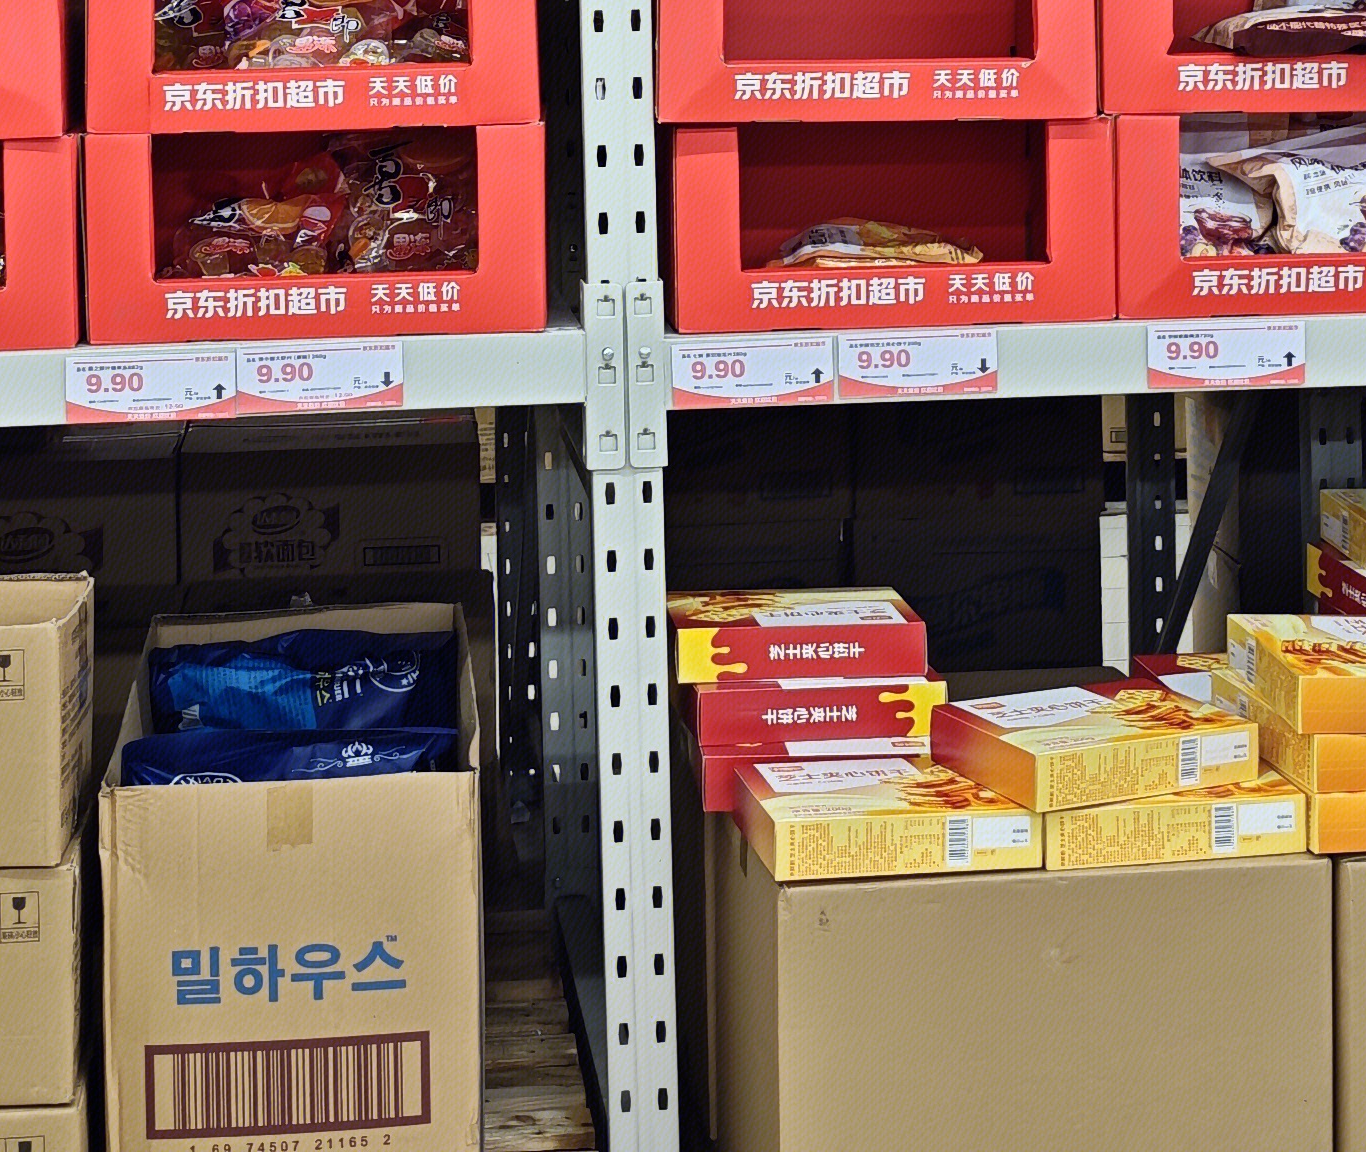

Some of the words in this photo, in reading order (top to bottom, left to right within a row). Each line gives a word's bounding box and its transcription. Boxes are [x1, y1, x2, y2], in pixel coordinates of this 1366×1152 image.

[369, 75, 457, 96] 天天低价
[735, 71, 910, 100] 京东折扣超市
[933, 68, 1019, 87] 天天低价
[1177, 61, 1348, 91] 京东折扣超市
[163, 79, 345, 112] 京东折扣超市
[948, 272, 1034, 292] 天天低价
[1192, 265, 1365, 297] 京东折扣超市
[371, 283, 460, 302] 天天低价
[751, 276, 925, 308] 京东折扣超市
[166, 287, 347, 320] 京东折扣超市
[857, 349, 910, 370] 9.90
[1166, 341, 1219, 360] 9.90
[257, 363, 313, 384] 9.90
[691, 359, 745, 379] 9.90
[86, 374, 144, 393] 9.90
[172, 940, 406, 1005] 밀하우스
[247, 1141, 300, 1152] 74507
[315, 1136, 368, 1150] 21165
[383, 1134, 390, 1145] 2
